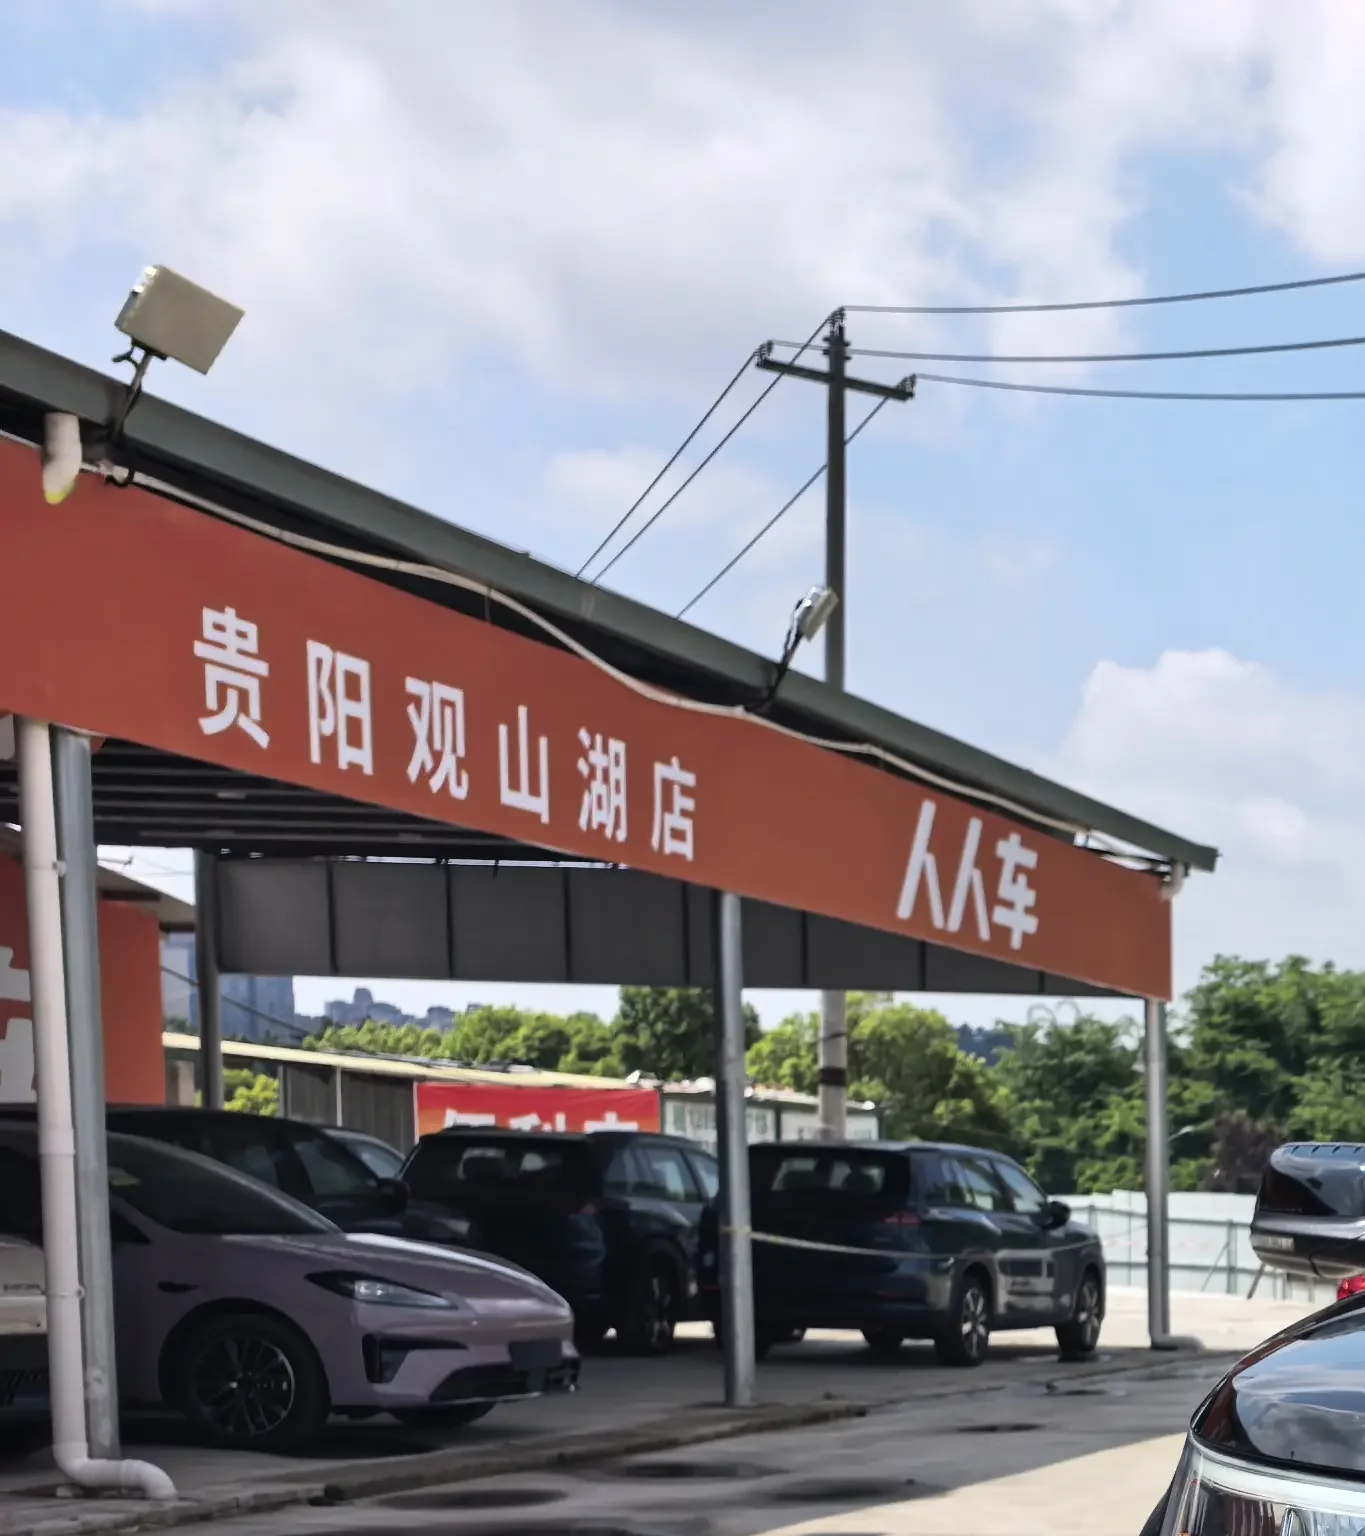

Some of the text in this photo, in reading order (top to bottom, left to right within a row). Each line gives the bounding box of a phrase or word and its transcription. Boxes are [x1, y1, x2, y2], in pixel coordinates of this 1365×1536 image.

[193, 606, 697, 862] 贵阳观山湖店
[896, 799, 1039, 950] 人人车
